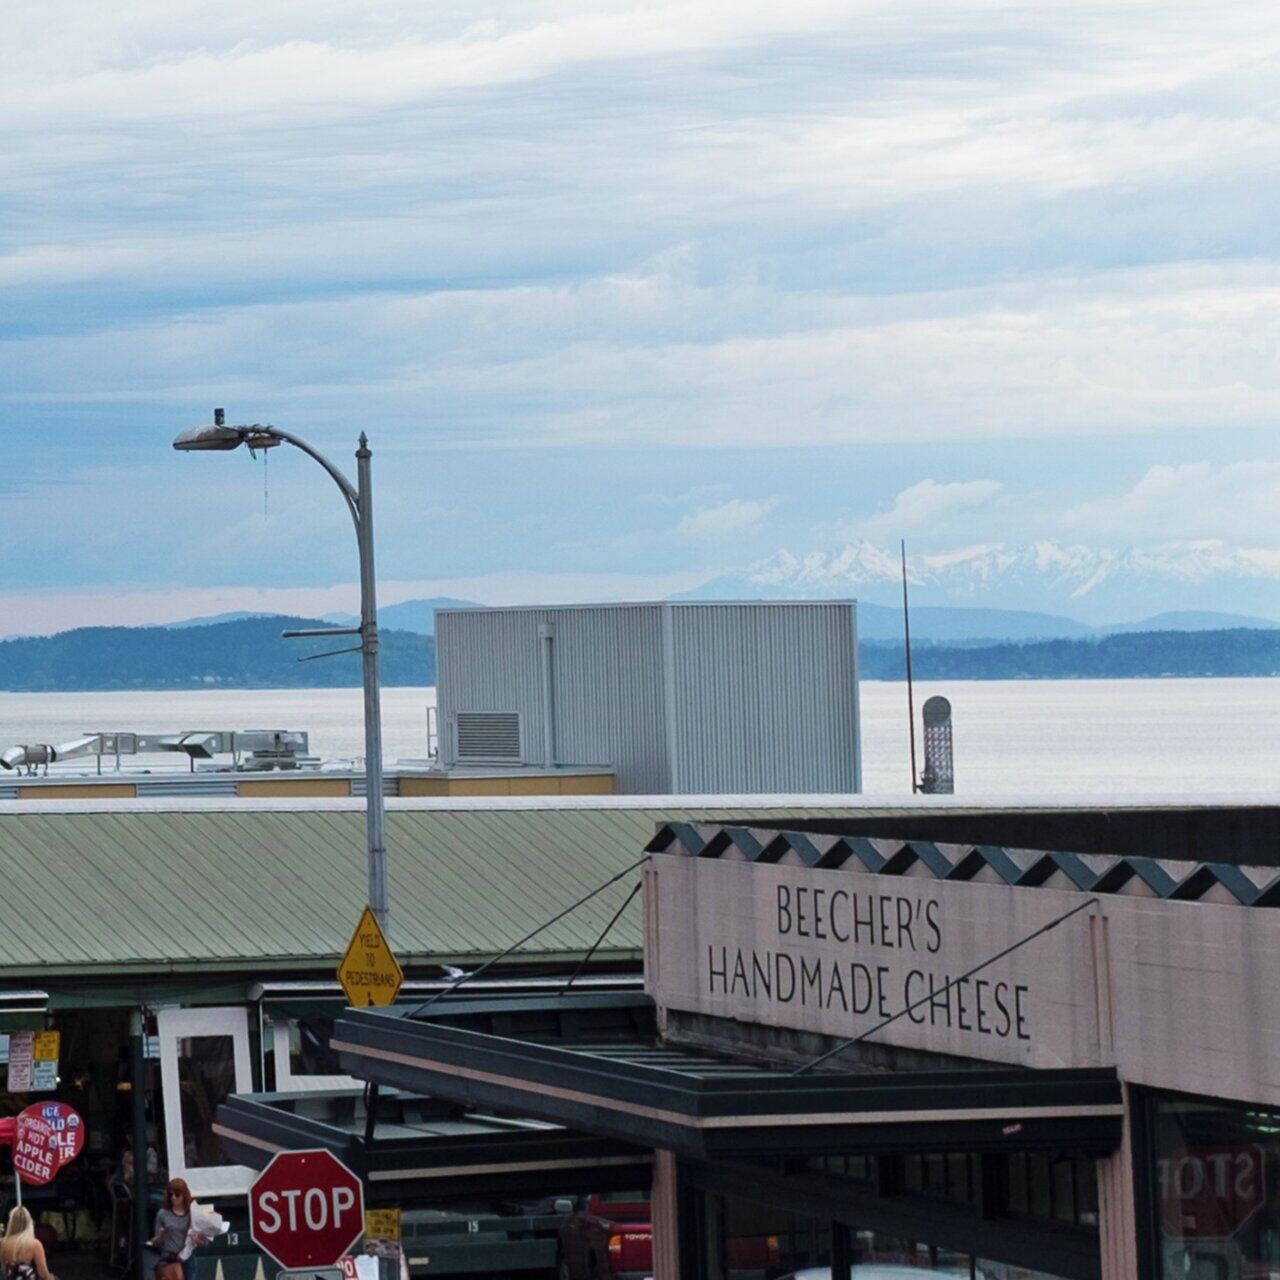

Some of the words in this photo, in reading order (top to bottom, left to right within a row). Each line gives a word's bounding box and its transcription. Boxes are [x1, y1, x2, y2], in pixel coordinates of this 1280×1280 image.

[777, 884, 941, 954] BEECHER'S
[359, 933, 380, 949] YIELD
[365, 952, 375, 968] TO
[346, 970, 396, 988] PEDESTRIANS
[708, 944, 892, 1018] HANDMADE
[904, 969, 1031, 1041] CHEESE
[28, 1131, 46, 1146] HOT
[16, 1140, 53, 1166] APPLE
[14, 1154, 51, 1180] CIDER
[258, 1186, 355, 1234] STOP
[467, 1220, 479, 1233] 15
[227, 1233, 238, 1245] 13
